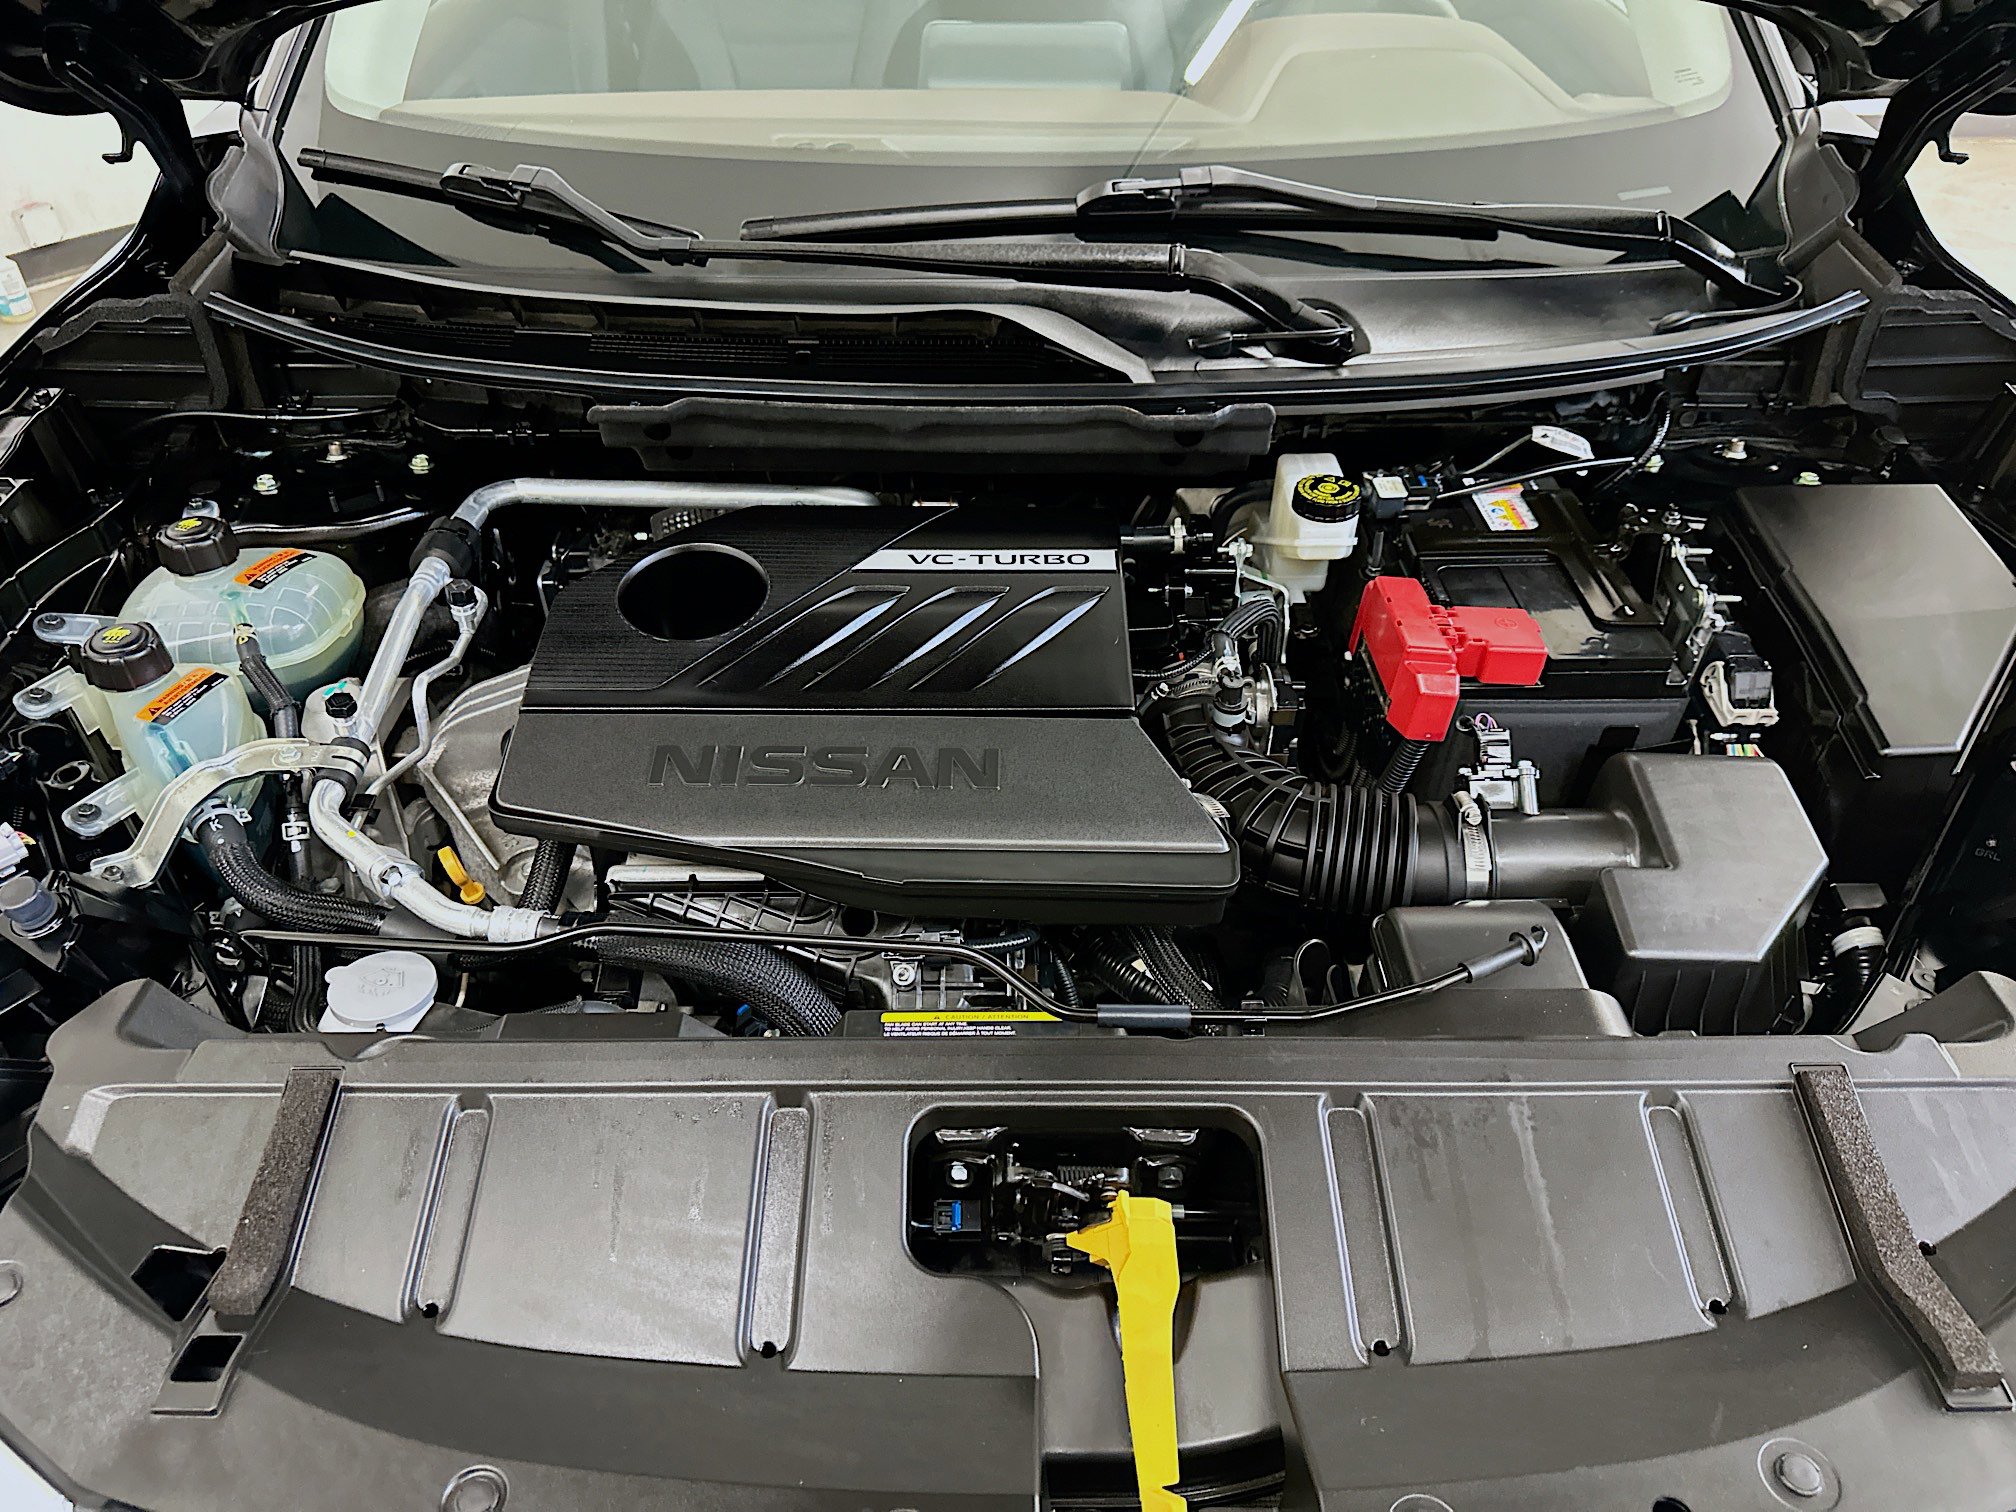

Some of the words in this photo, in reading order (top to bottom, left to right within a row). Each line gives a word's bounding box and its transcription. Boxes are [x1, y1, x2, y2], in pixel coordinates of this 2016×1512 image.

[907, 554, 1090, 565] VC-TURBO
[648, 745, 1000, 789] NISSAN
[209, 819, 223, 832] K
